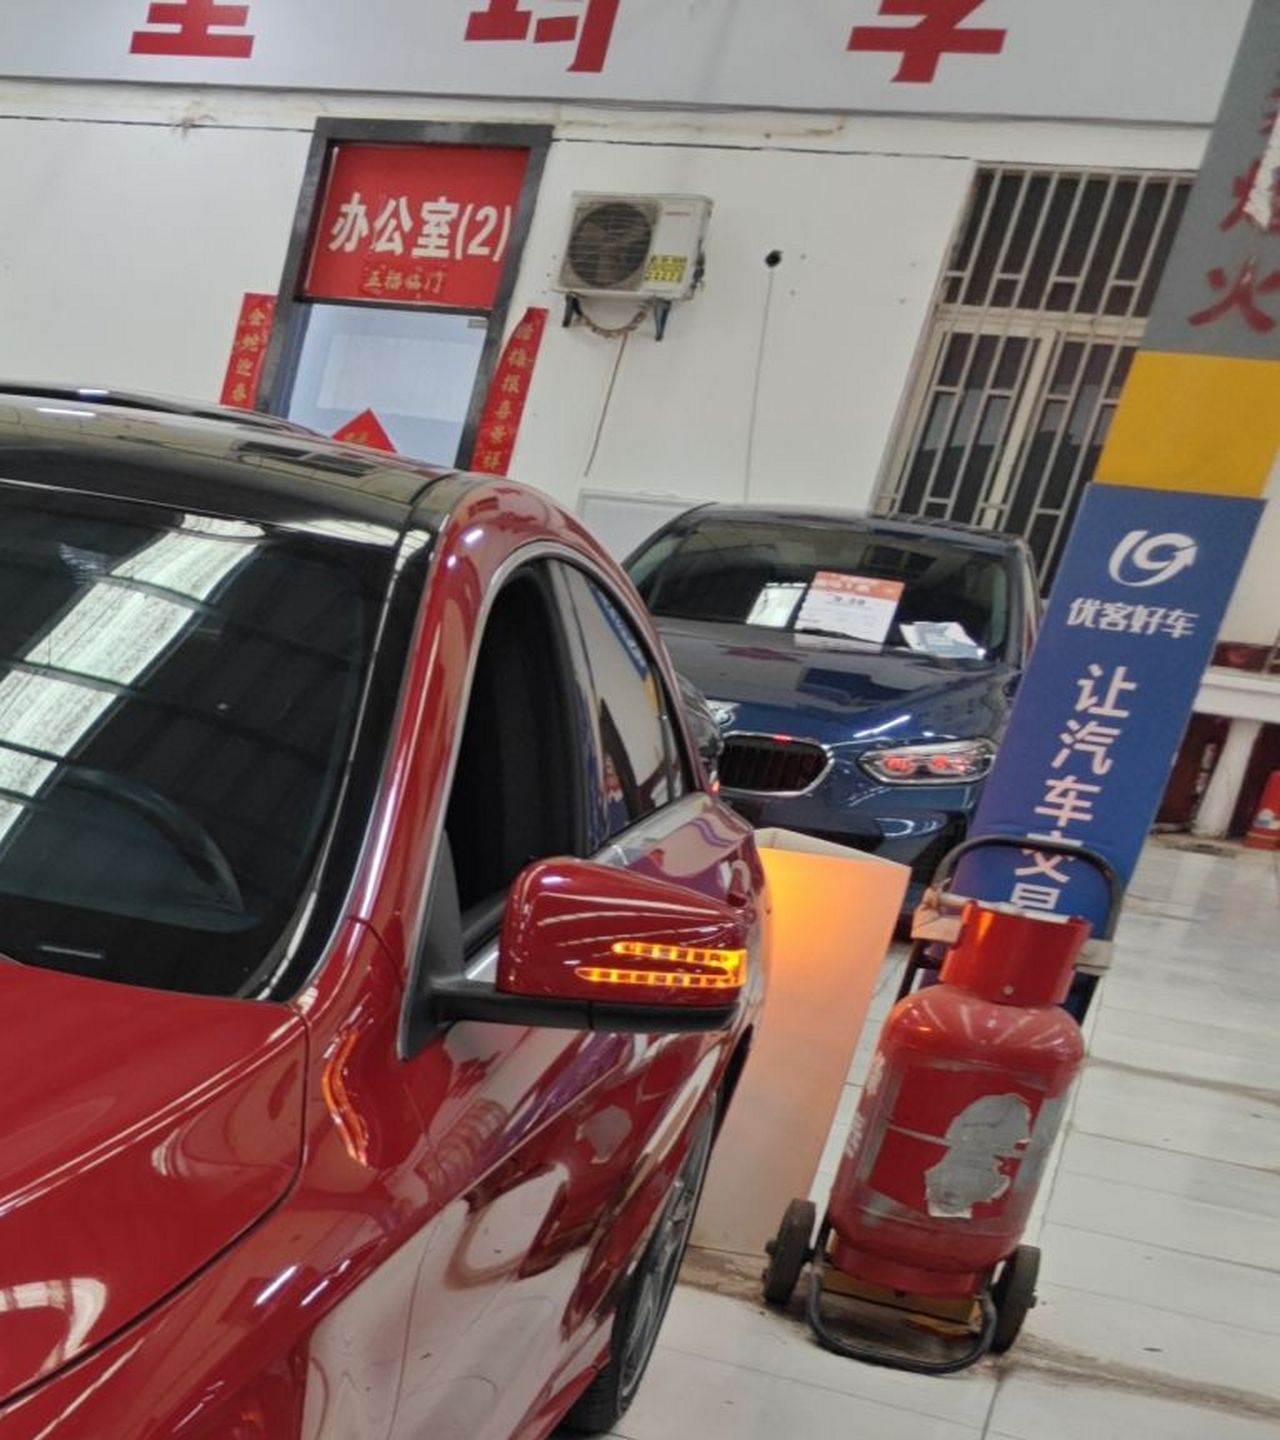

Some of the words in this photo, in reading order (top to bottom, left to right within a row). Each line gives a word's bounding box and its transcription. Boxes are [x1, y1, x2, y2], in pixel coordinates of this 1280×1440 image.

[328, 192, 512, 262] 办公室(2)
[1066, 597, 1200, 640] 优客好车
